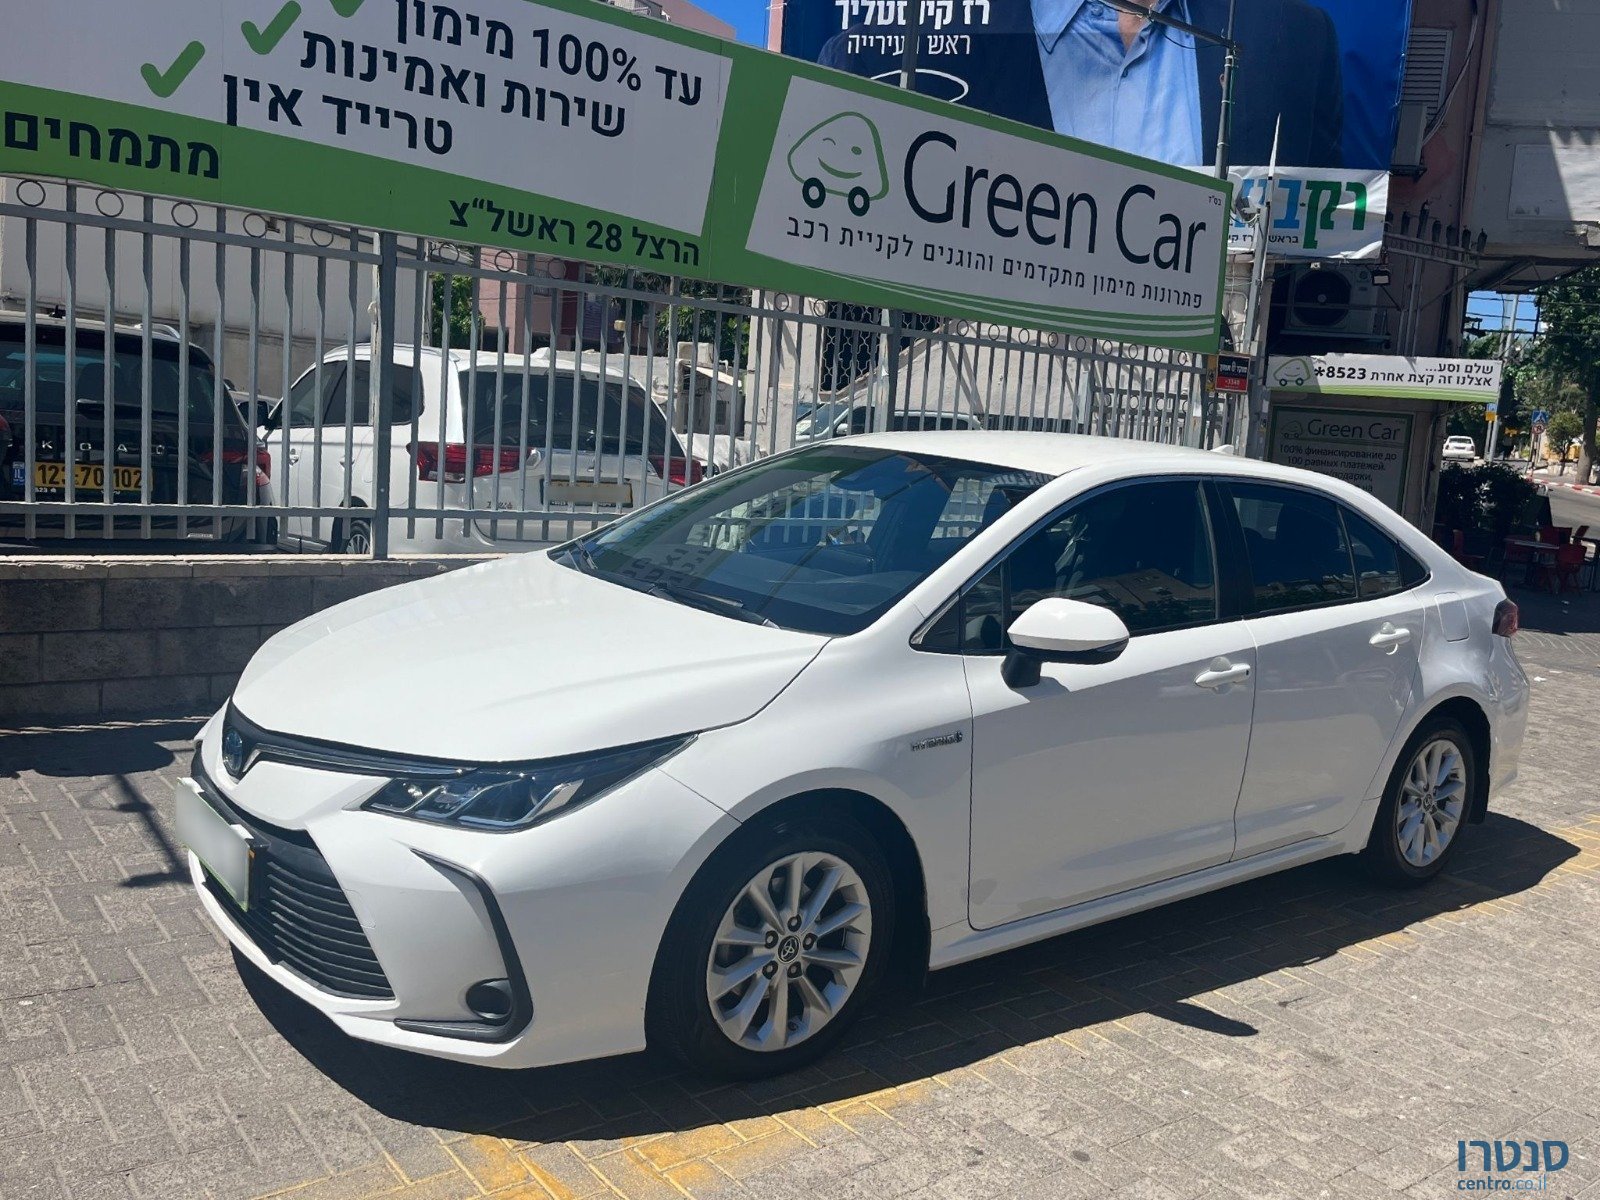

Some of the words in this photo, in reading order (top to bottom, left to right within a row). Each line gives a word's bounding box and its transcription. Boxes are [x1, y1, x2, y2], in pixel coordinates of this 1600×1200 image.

[963, 0, 991, 25] רז
[396, 0, 513, 60] מימון
[847, 34, 920, 56] עירייה
[927, 35, 971, 55] ראש
[300, 30, 486, 108] ואמינות
[533, 28, 642, 91] 100%
[655, 65, 702, 106] עד
[223, 74, 303, 127] אין
[501, 79, 625, 138] שירות
[322, 95, 453, 155] טרייד
[4, 111, 219, 179] מתמחים
[904, 130, 1097, 254] Green
[1115, 184, 1206, 274] Car
[586, 220, 622, 252] 28
[786, 216, 830, 242] רכב
[632, 226, 699, 267] הרצל
[839, 226, 914, 260] לקניית
[923, 243, 994, 272] והוגנים
[1003, 258, 1085, 288] מתקדמים
[1093, 274, 1135, 297] מימון
[1143, 284, 1203, 309] פתרונות
[1370, 372, 1404, 382] אחרת
[1407, 373, 1434, 386] קצת
[1438, 375, 1451, 384] זה
[1456, 374, 1492, 387] אצלנו
[1464, 362, 1494, 375] שלם
[1307, 419, 1363, 438] Green
[1368, 422, 1400, 440] Car
[1280, 444, 1303, 454] 100%
[1304, 446, 1384, 460] финансирование
[1288, 456, 1302, 465] 100
[1304, 458, 1339, 468] равных
